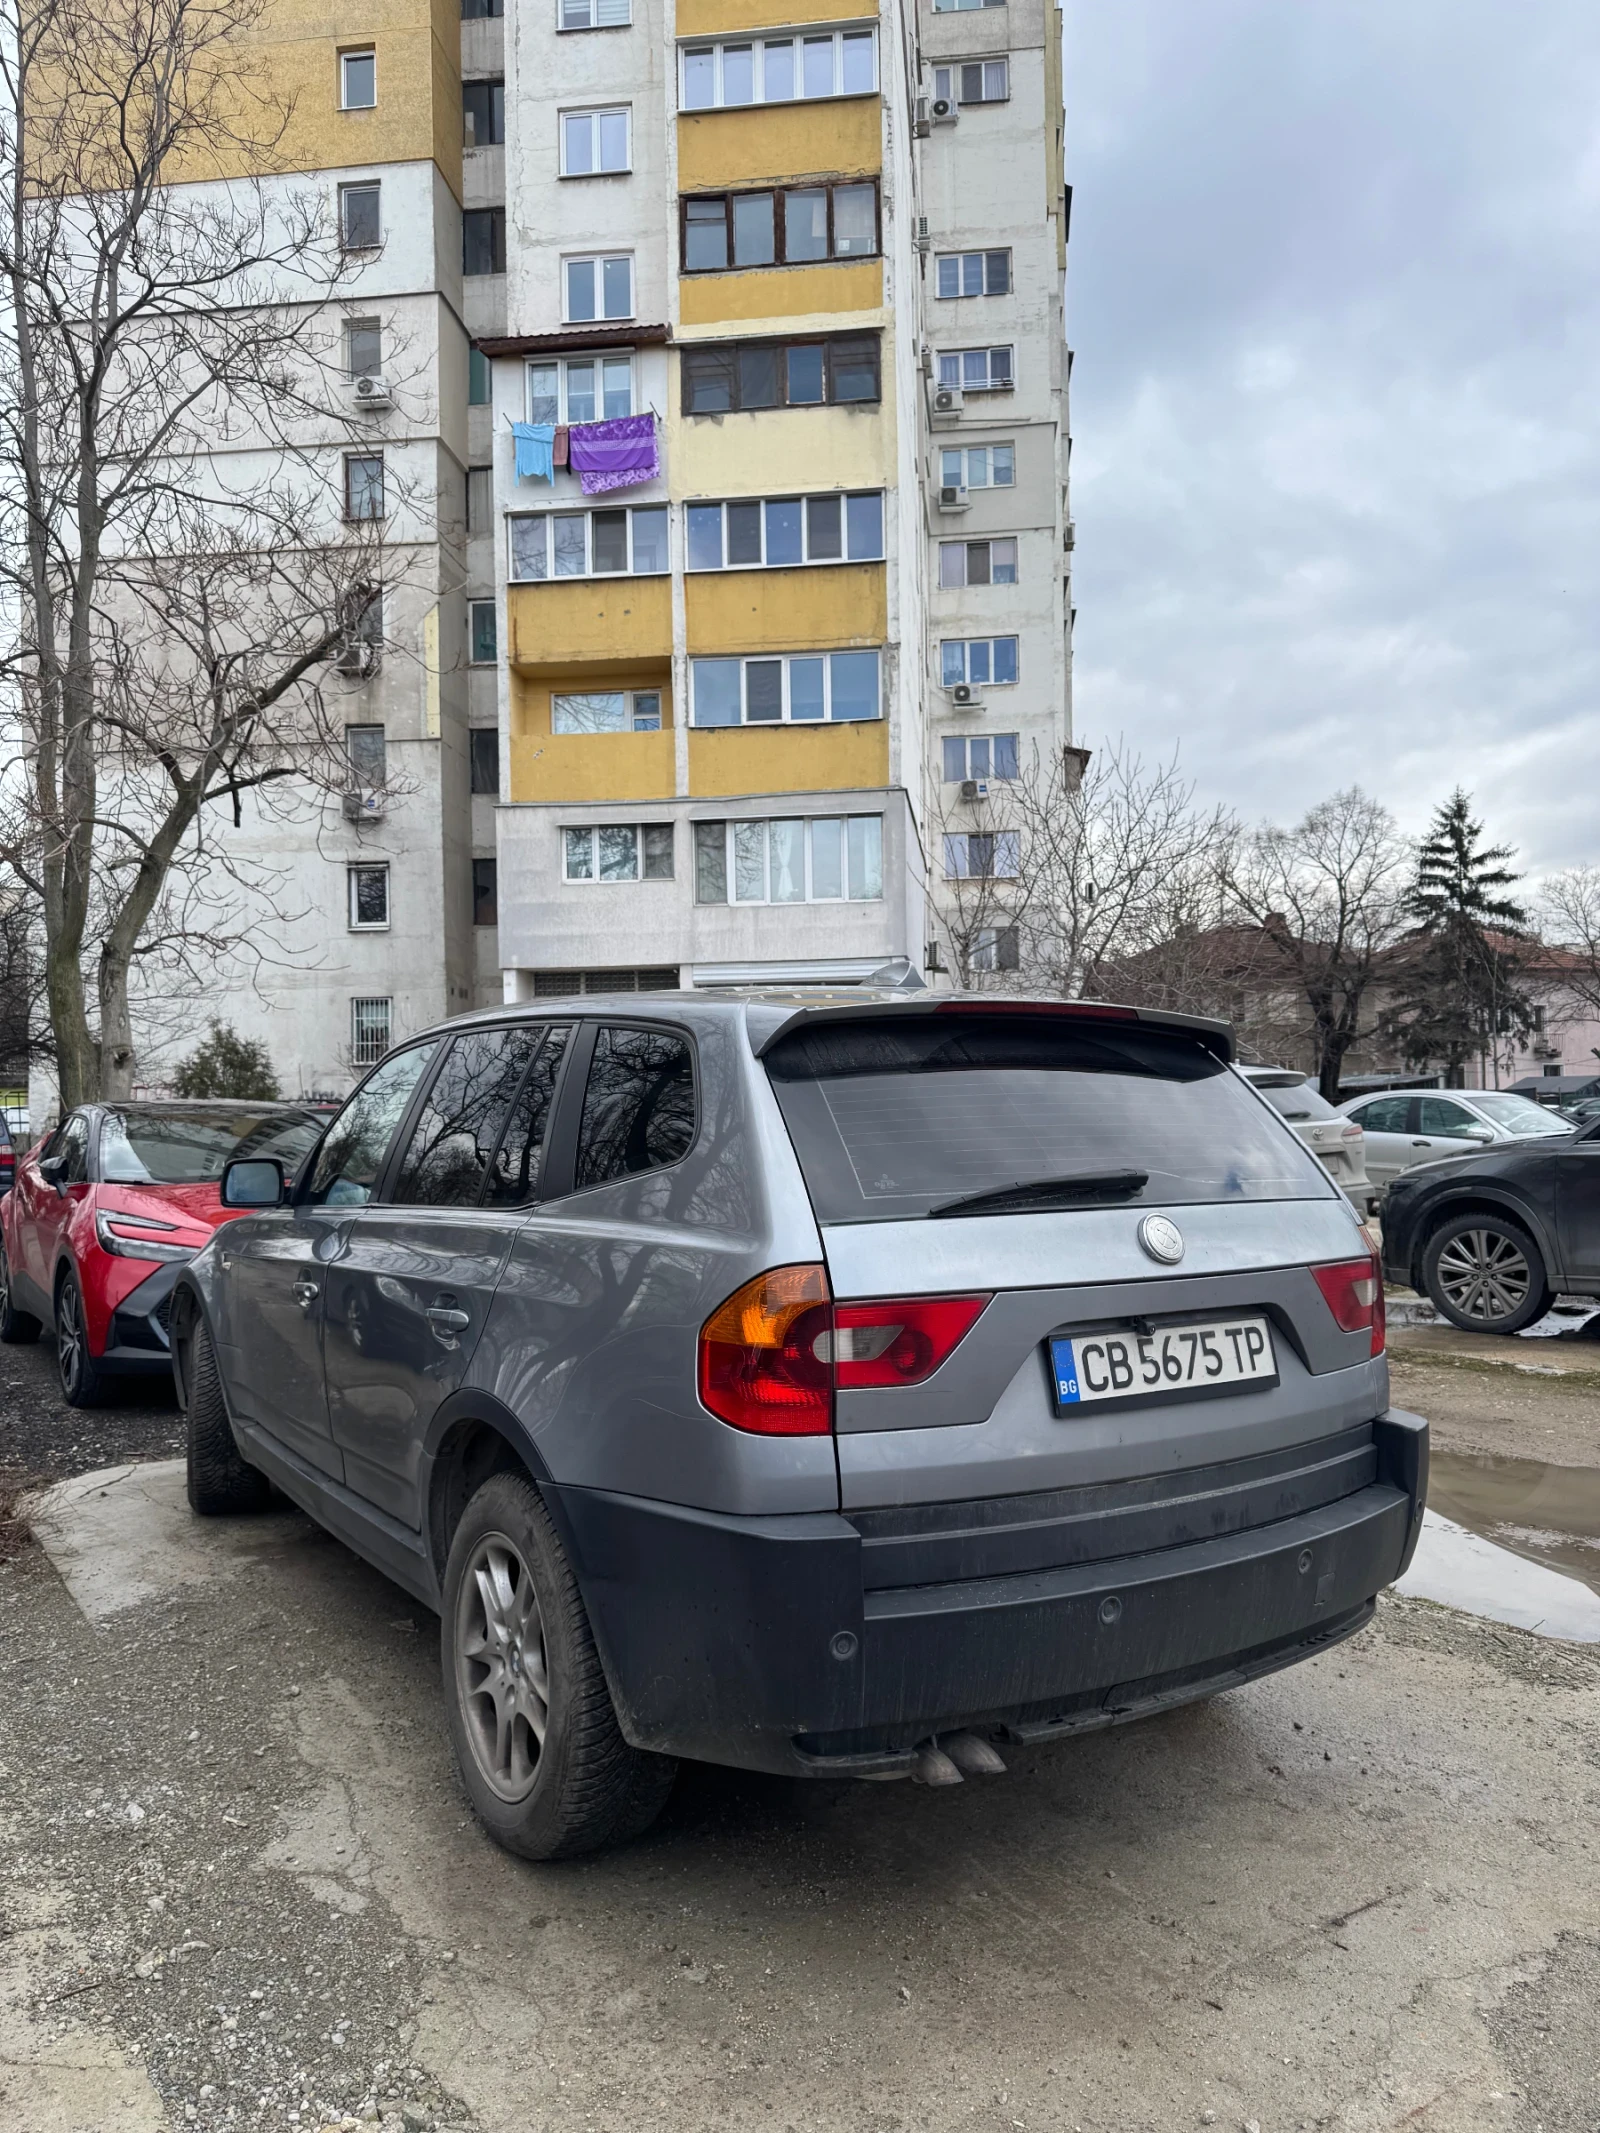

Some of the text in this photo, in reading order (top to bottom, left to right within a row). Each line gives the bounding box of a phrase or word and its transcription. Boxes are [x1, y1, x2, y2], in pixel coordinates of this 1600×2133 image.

[1081, 1326, 1264, 1392] CB 5675 TP
[1060, 1379, 1077, 1395] BG
